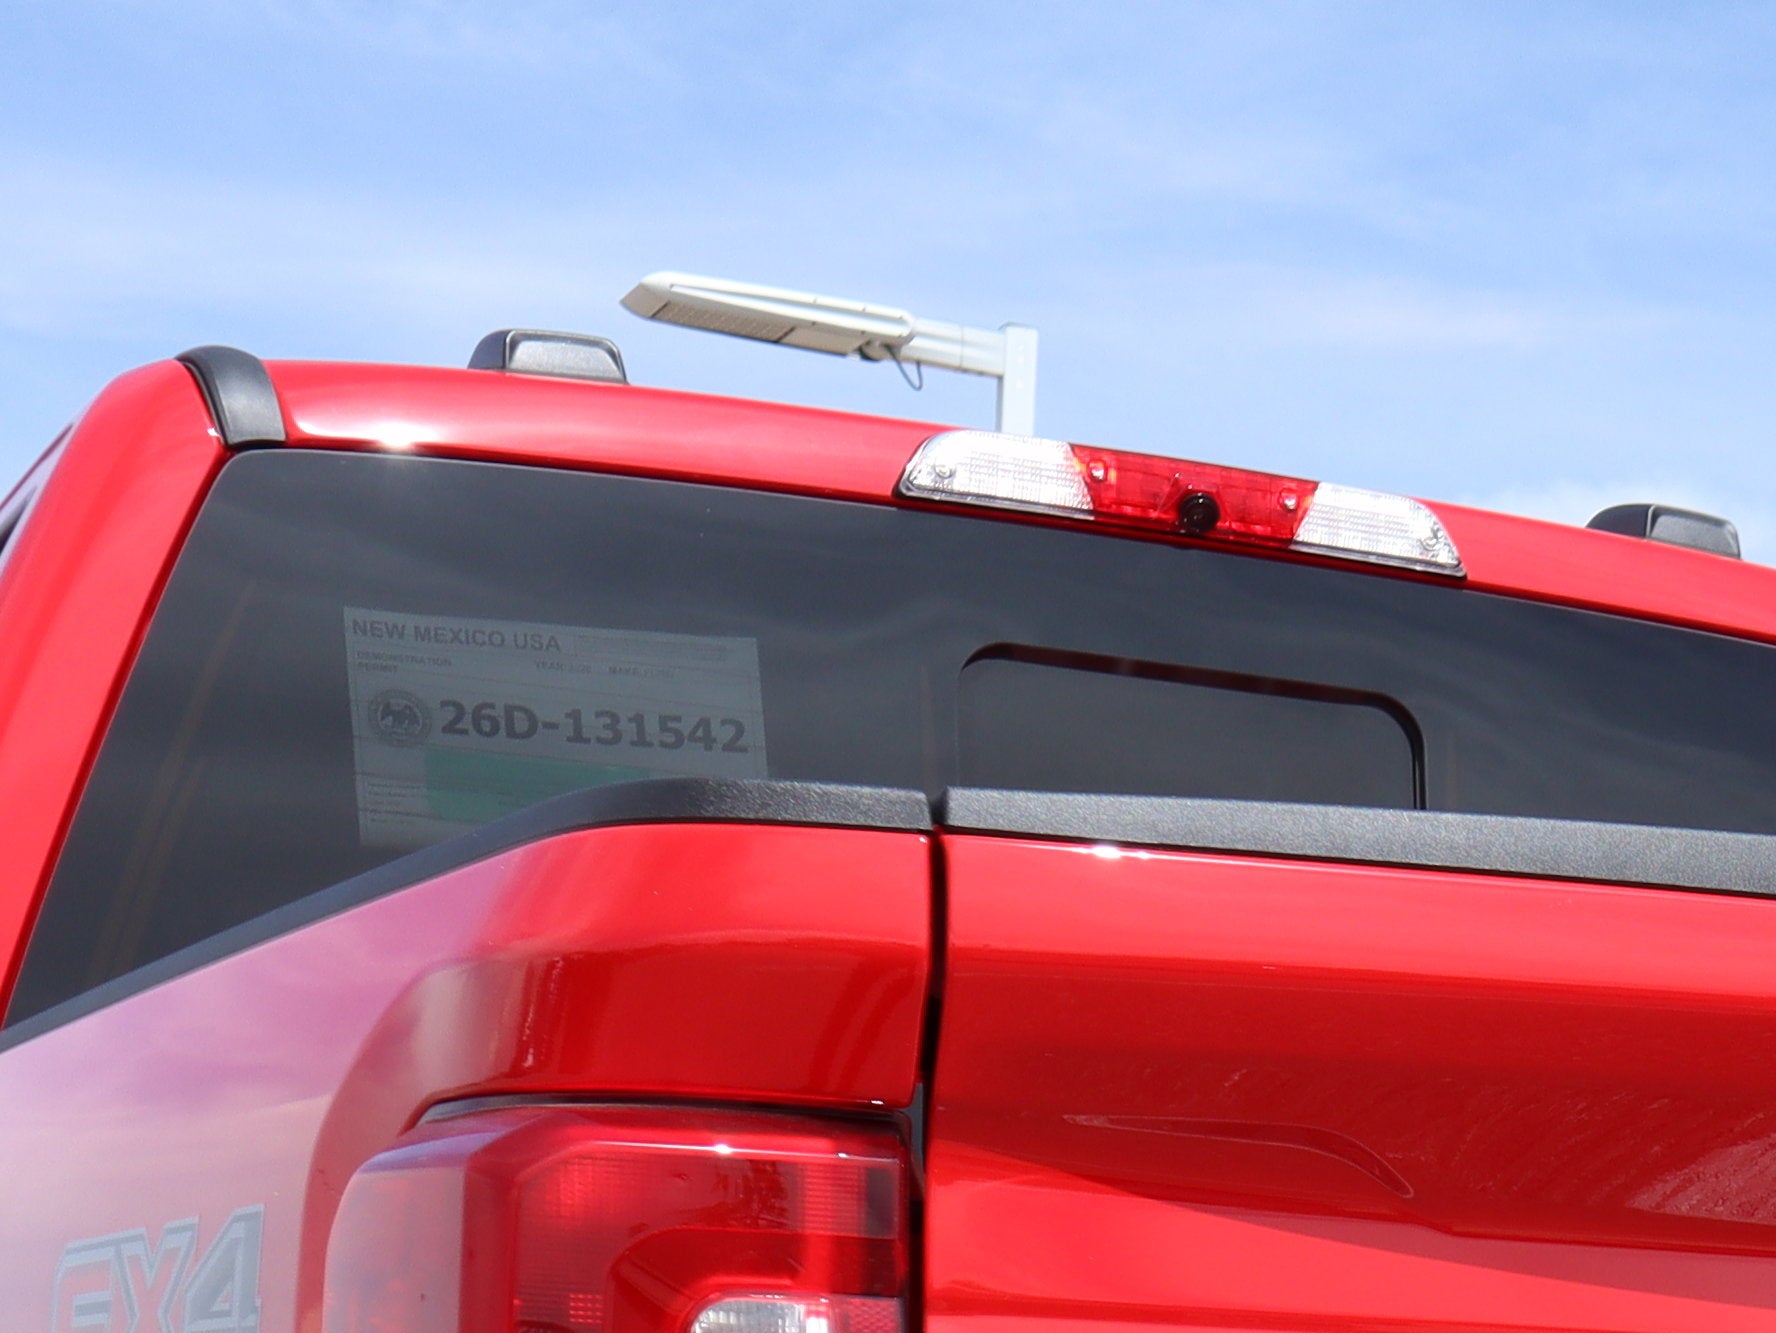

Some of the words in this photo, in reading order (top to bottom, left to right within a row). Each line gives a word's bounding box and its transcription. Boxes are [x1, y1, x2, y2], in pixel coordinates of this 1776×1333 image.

[351, 618, 406, 640] NEW
[414, 624, 506, 648] MEXICO
[512, 631, 562, 652] USA
[438, 699, 750, 754] 26D-131542
